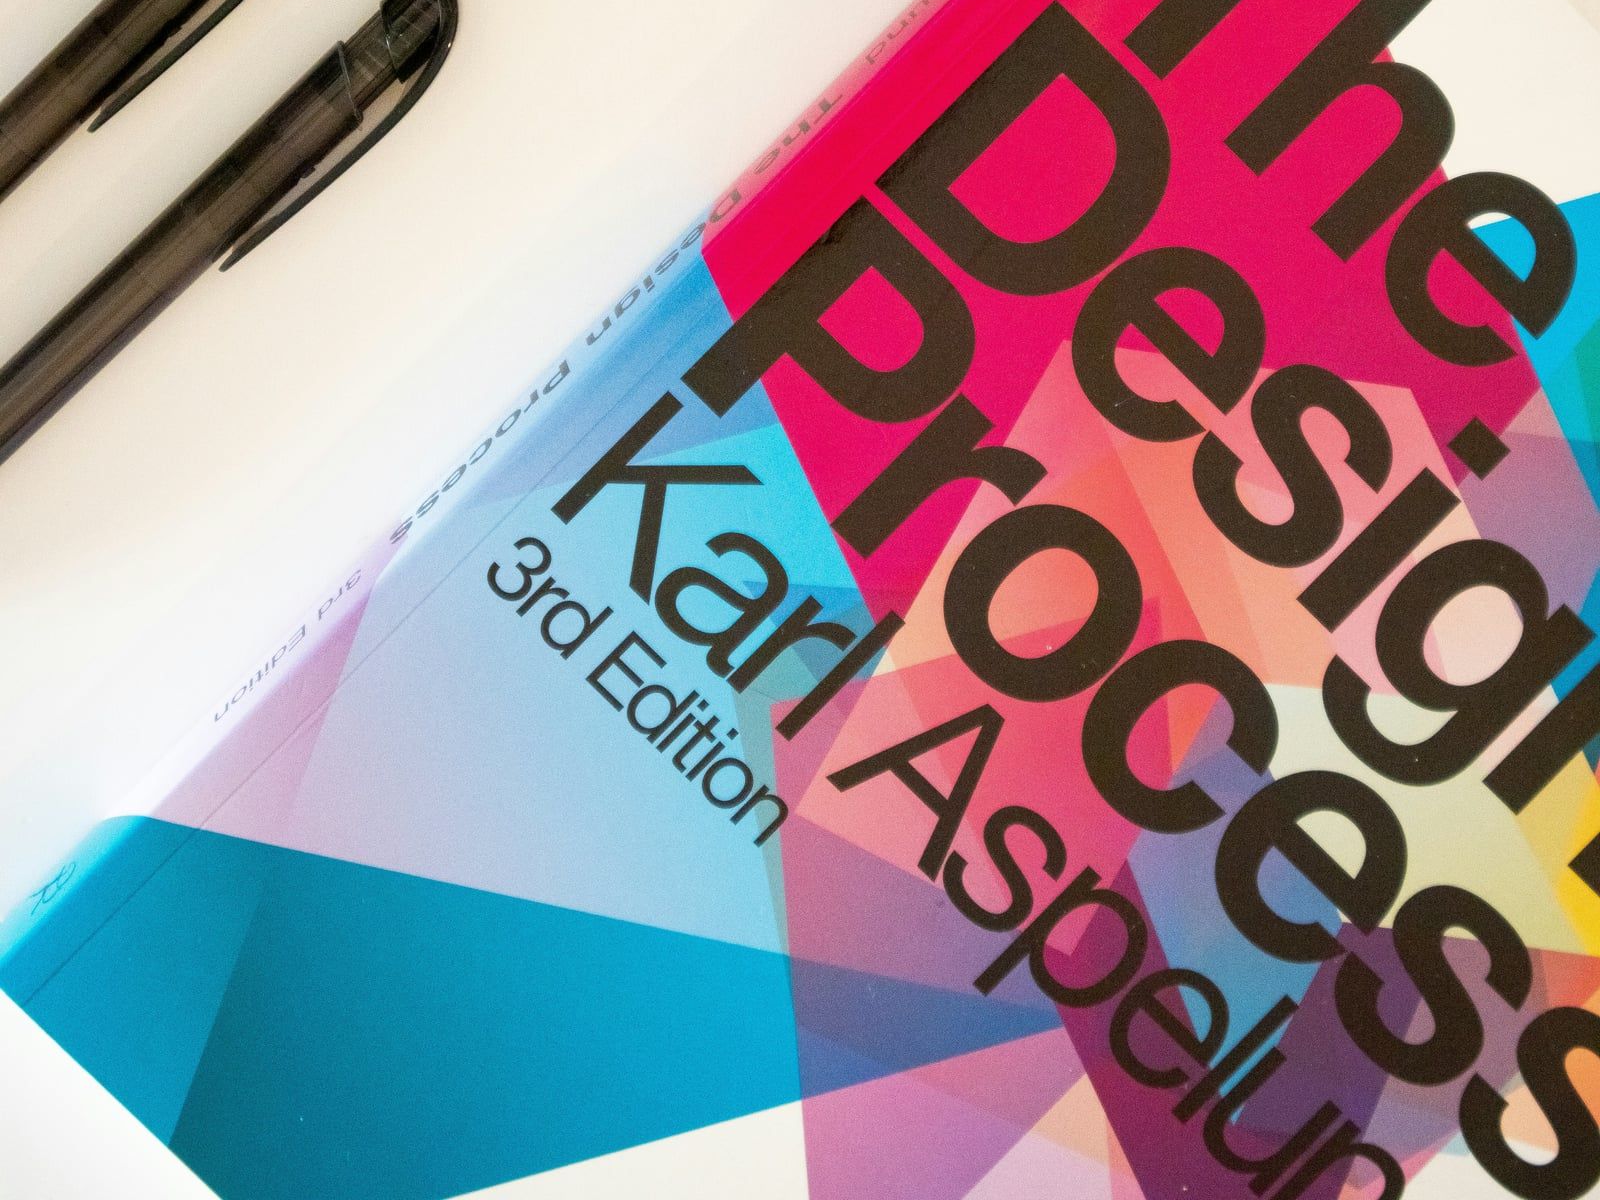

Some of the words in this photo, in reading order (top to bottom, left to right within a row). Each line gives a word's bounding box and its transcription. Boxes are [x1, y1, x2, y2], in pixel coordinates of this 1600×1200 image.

[752, 94, 844, 175] The
[586, 188, 743, 347] Design
[317, 569, 363, 622] 3rd
[550, 390, 906, 742] Karl
[213, 623, 308, 723] Edition
[486, 536, 614, 660] 3rd
[585, 630, 790, 848] Edition
[680, 195, 1600, 1200] Process
